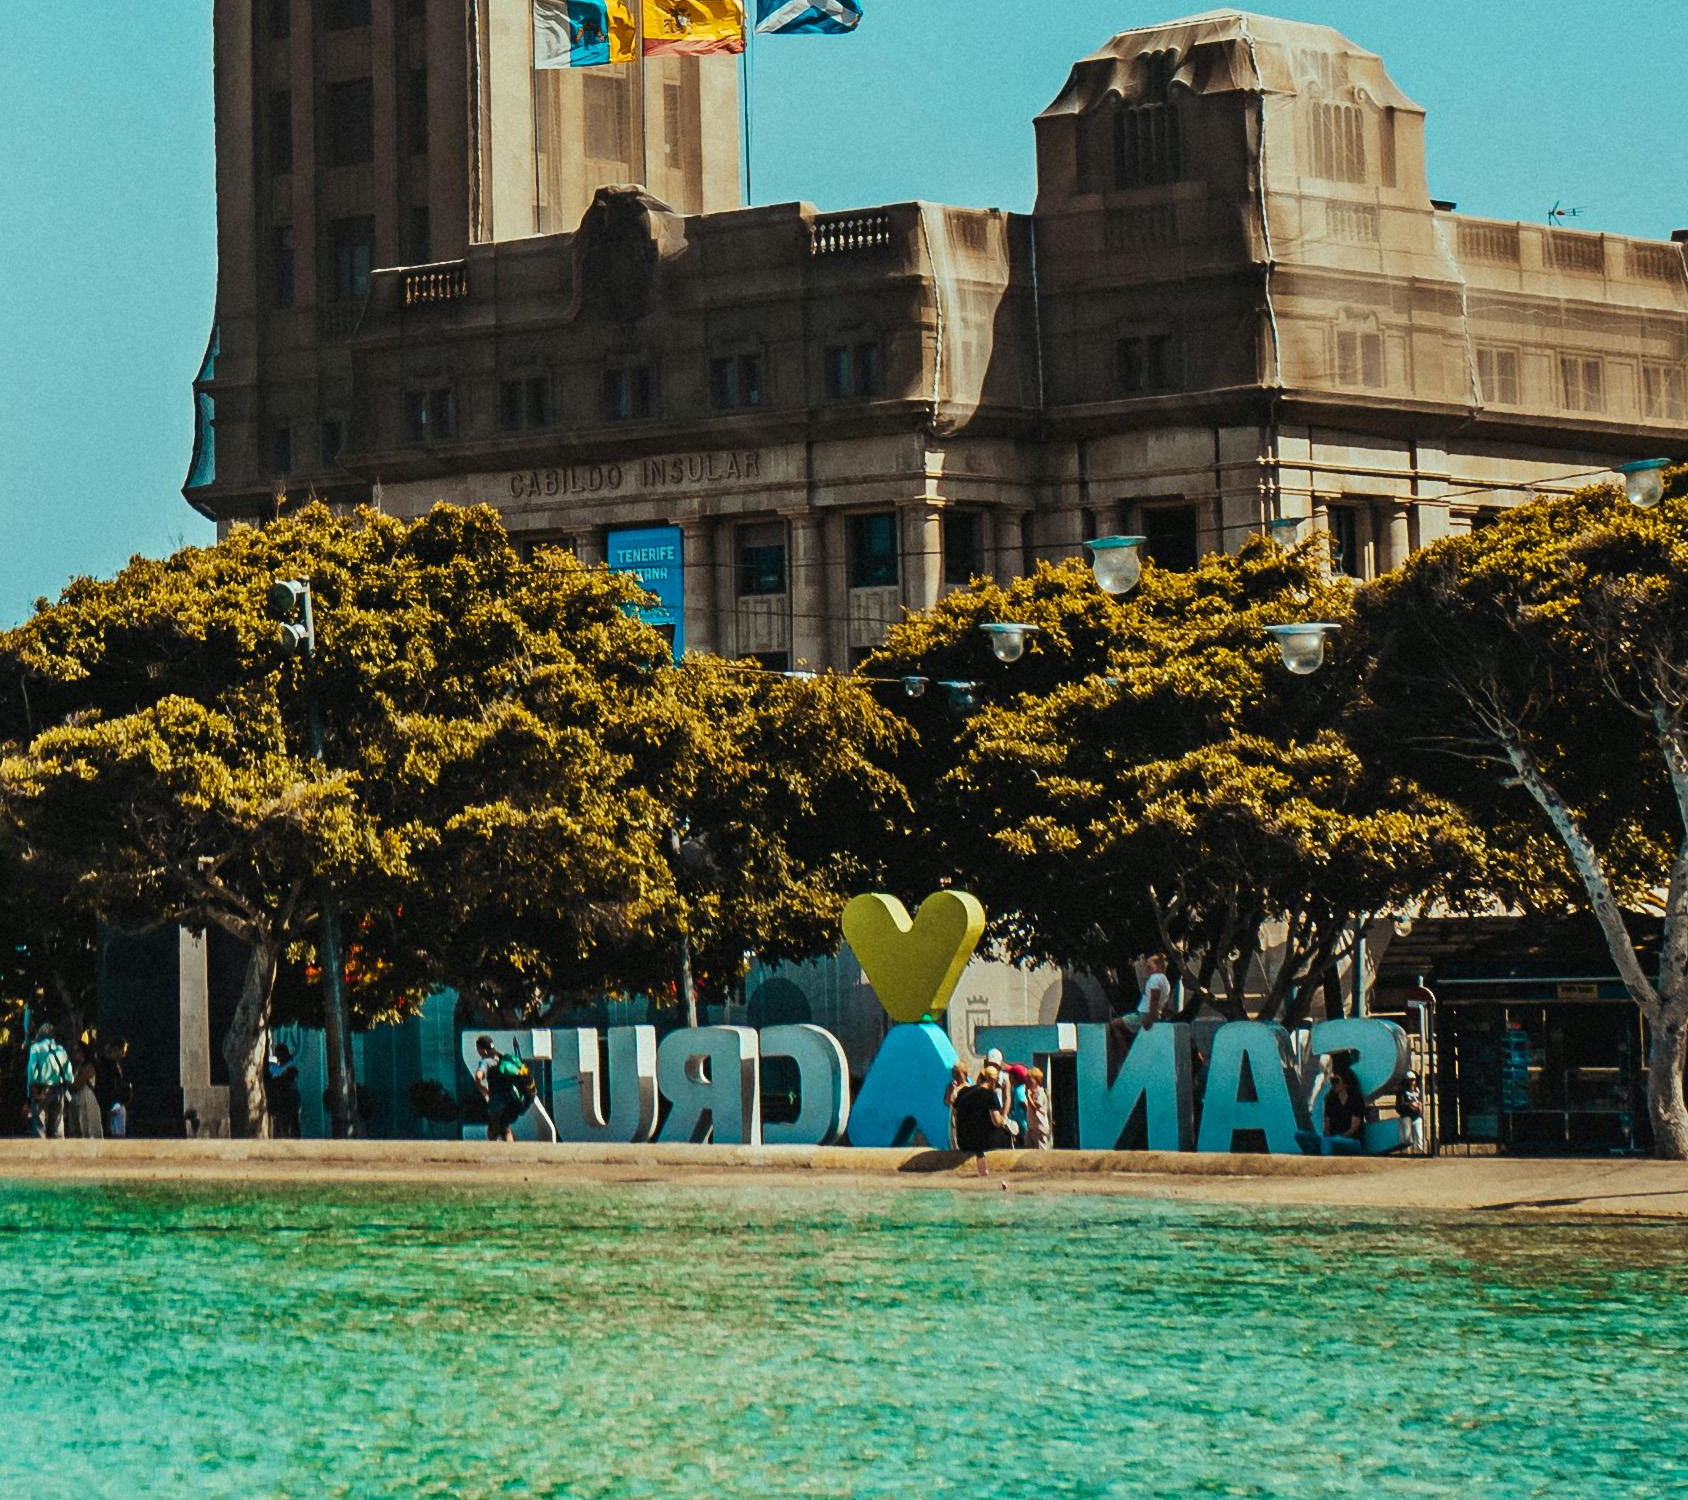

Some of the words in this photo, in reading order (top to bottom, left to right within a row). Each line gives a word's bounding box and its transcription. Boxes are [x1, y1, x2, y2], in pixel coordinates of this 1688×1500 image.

[509, 464, 623, 497] CABILDO
[642, 452, 760, 486] INSULAR
[616, 545, 675, 563] TENERIFE
